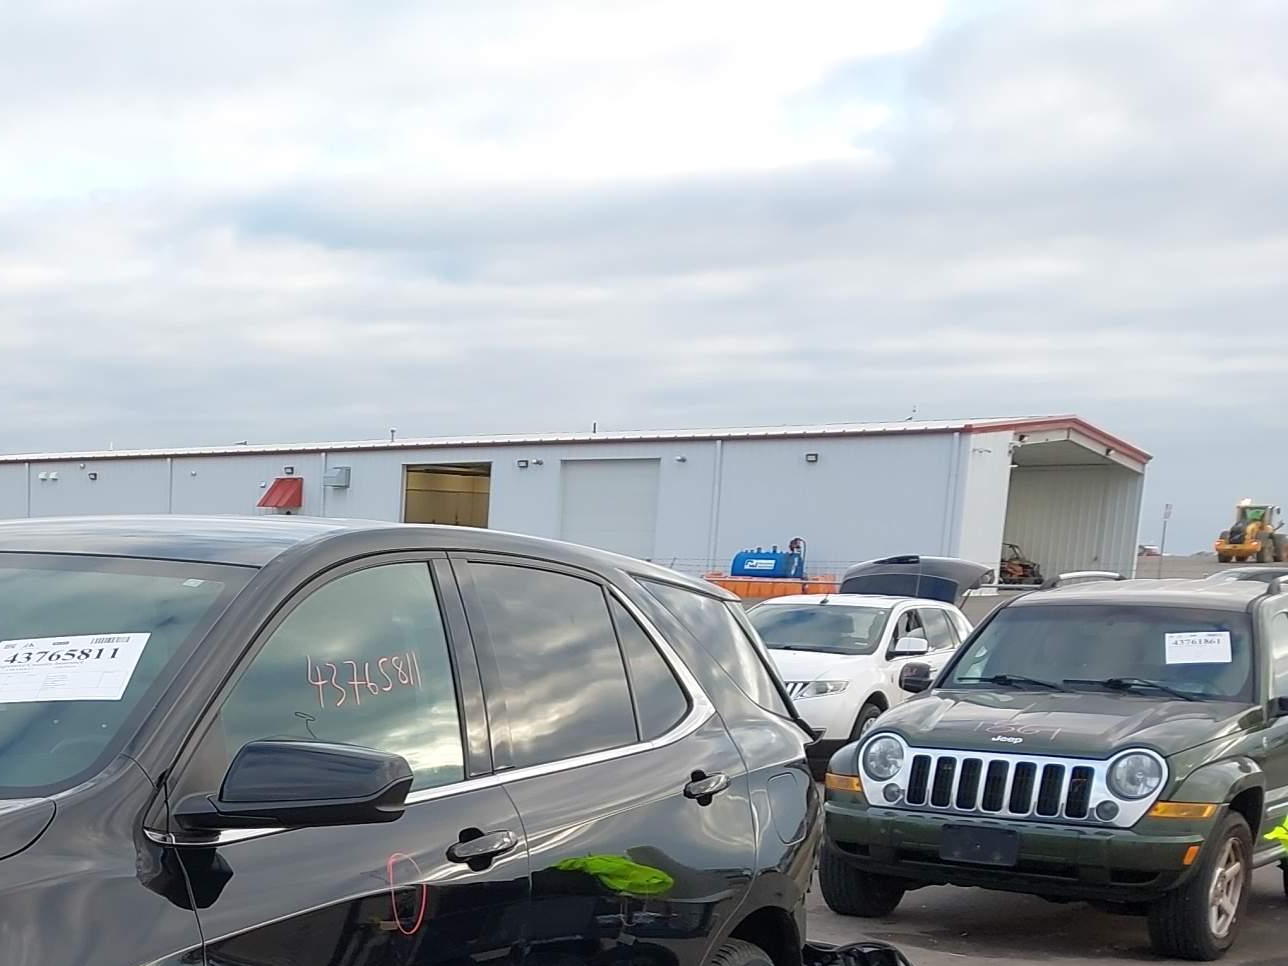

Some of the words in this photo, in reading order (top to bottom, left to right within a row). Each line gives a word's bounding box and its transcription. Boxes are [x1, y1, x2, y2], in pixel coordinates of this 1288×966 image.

[3, 647, 120, 664] 43765811
[307, 652, 422, 709] 43765811
[991, 735, 1024, 744] Jeep
